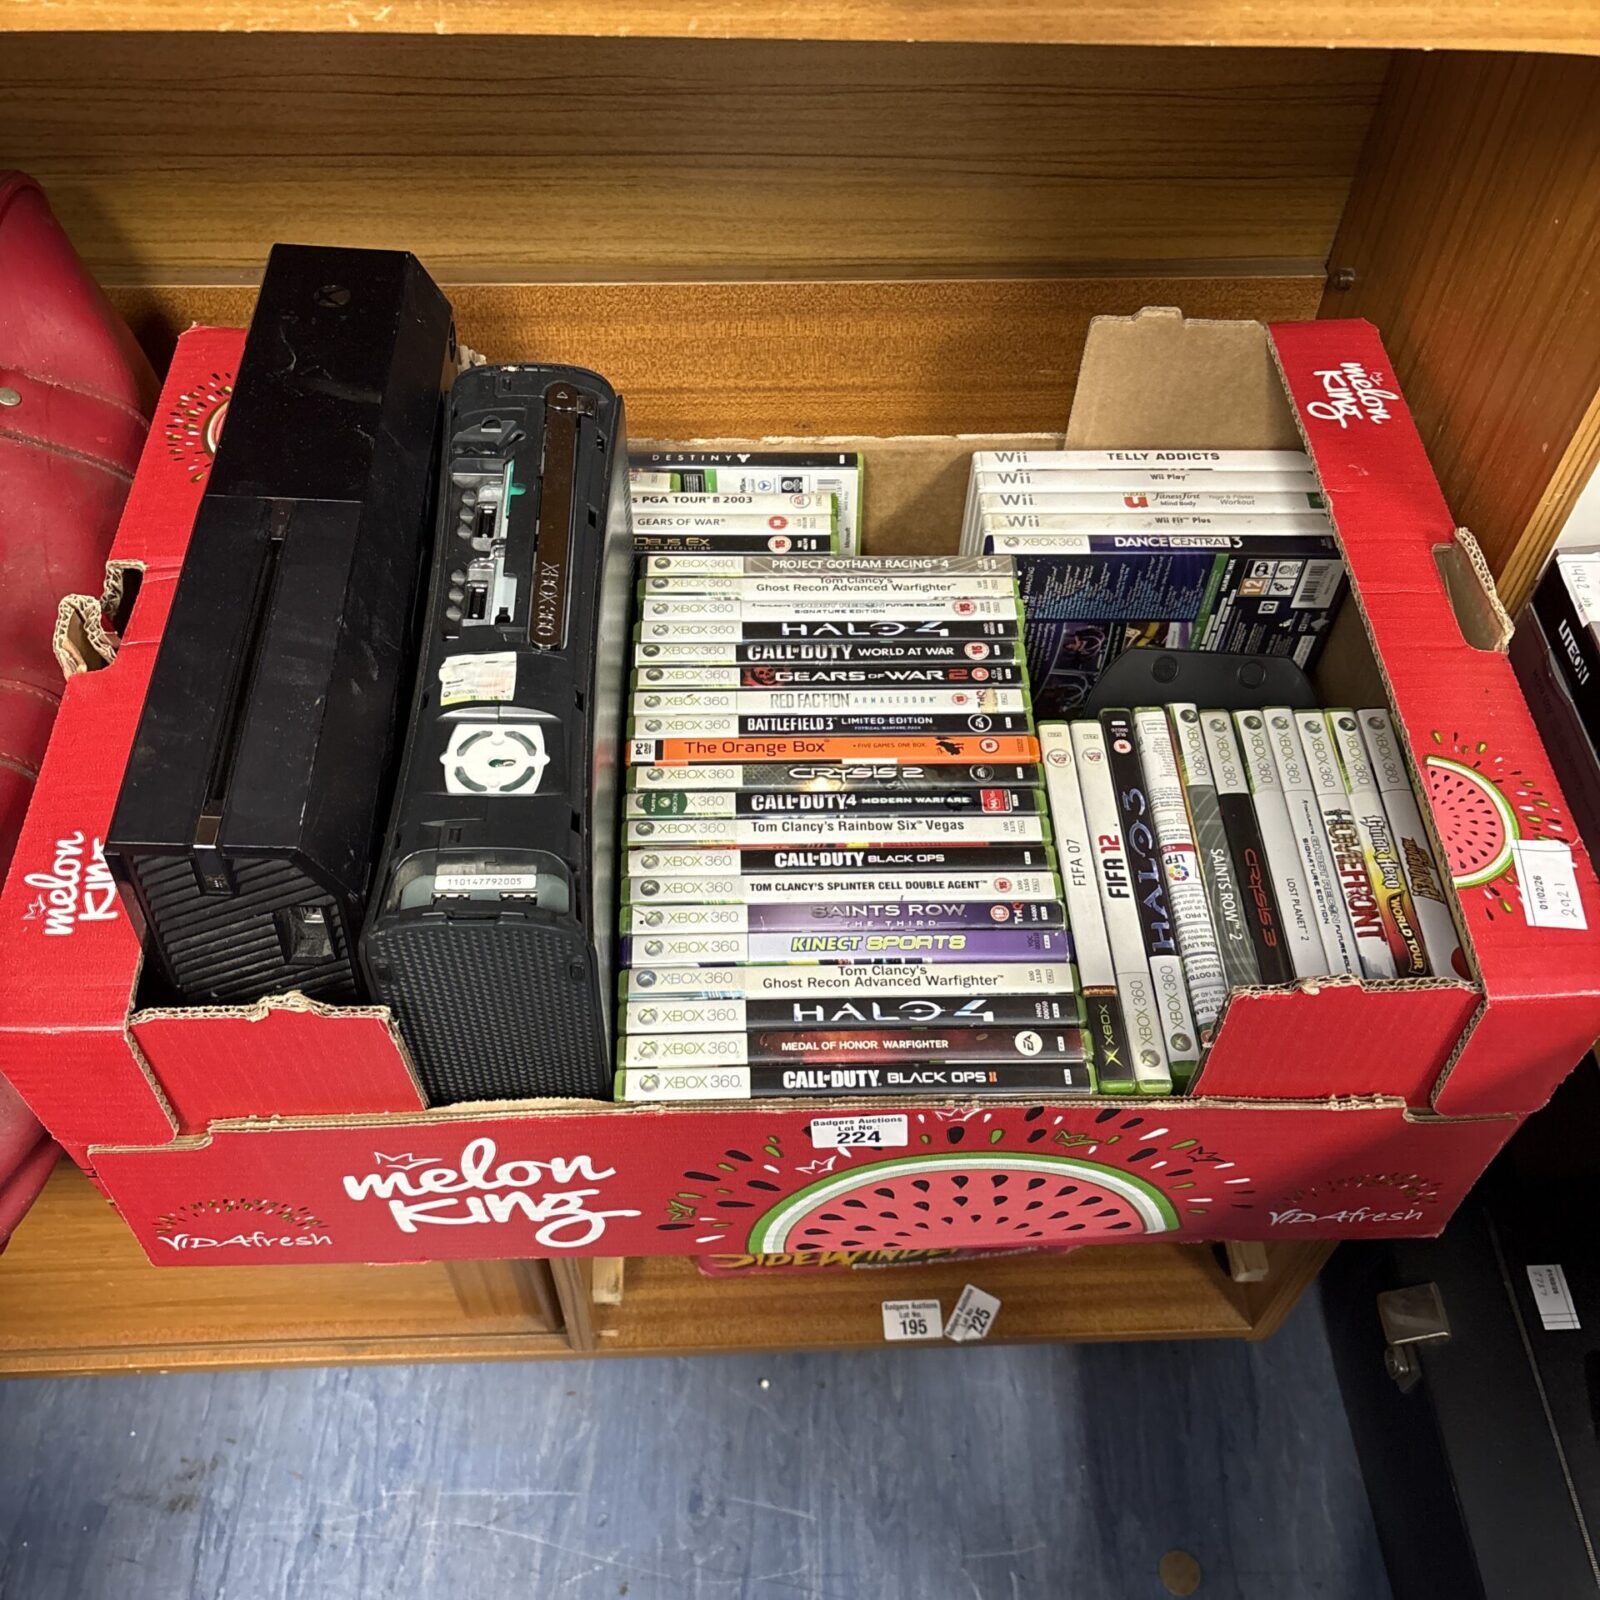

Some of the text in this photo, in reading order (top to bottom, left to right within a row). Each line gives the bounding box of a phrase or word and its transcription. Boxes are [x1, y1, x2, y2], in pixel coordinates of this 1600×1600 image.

[1340, 362, 1399, 424] melon
[995, 452, 1027, 463] Wii
[1156, 452, 1220, 460] ADDICTS
[998, 473, 1031, 484] Wii
[1000, 494, 1034, 505] Wii
[638, 518, 692, 526] GEARS OF
[1007, 516, 1040, 527] Wii
[1023, 537, 1082, 546] XBOX 360
[1114, 537, 1243, 548] DANCE CENTRAL 3
[772, 559, 949, 569] PROJECT GOTHAM 4
[672, 579, 732, 588] XBOX 360
[757, 583, 887, 592] Ghost Recon Advanced
[847, 576, 893, 585] Clancy's
[537, 562, 560, 636] XBOX 360
[672, 626, 735, 635] XBOX 360
[782, 621, 949, 637] HALO 4
[747, 644, 954, 660] CALL DUTY WORLD AT WAR
[1558, 619, 1590, 685] LITEON
[667, 670, 730, 680] XBOX 360
[775, 669, 968, 682] GEARS WAR 2
[771, 693, 932, 708] RED FACTION ARMAGEDDON
[666, 720, 731, 730] XBOX 360
[747, 718, 824, 731] BATTLEFIELD
[889, 717, 933, 725] EDITION
[684, 741, 787, 757] The Orange
[1216, 735, 1238, 787] XBOX 360
[1278, 732, 1301, 784] XBOX 360
[1346, 733, 1370, 785] XBOX 360
[1375, 732, 1399, 784] XBOX 360
[668, 769, 734, 779] XBOX 360
[902, 767, 924, 778] 2
[751, 795, 794, 810] CALL
[1122, 788, 1145, 816] 3
[658, 823, 726, 833] XBOX 360
[753, 820, 965, 834] Tom Clancy's Rainbow Vegas
[775, 852, 945, 868] CALL DUTY BLACK OPS
[1067, 839, 1086, 886] FIFA 07
[1099, 835, 1130, 899] FIFA 12
[1211, 849, 1232, 890] SAINTS
[1324, 809, 1387, 944] HOMEFRONT
[24, 831, 85, 935] melon
[664, 882, 733, 893] XBOX 360
[750, 881, 945, 891] TOM CLANCY'S SPLINTER CELL DOUBLE
[1129, 820, 1175, 952] HALO
[1286, 878, 1298, 897] LOST
[1303, 838, 1320, 887] SIGNATURE
[1316, 890, 1330, 925] EDITION
[1244, 848, 1277, 947] CRYSIS 3
[812, 904, 900, 918] SAINTS
[1390, 896, 1424, 970] WORLD TOUR
[668, 940, 740, 953] XBOX 360
[791, 935, 966, 952] KINECT SPORTS
[839, 965, 927, 977] Tom Clancy's
[763, 976, 921, 989] Ghost Recon Advanced
[1160, 966, 1186, 1030] XBOX 360
[662, 1009, 738, 1022] XBOX 360
[794, 1000, 994, 1022] HALO 4
[1129, 980, 1153, 1047] XBOX 360
[1098, 1004, 1115, 1045] XBOX
[781, 1040, 949, 1051] MEDAL OF HONOR WARFIGHTER
[664, 1075, 742, 1089] XBOX 360
[783, 1071, 986, 1088] CALL BLACK OPS
[813, 1116, 903, 1127] Badgers Auctions
[837, 1131, 882, 1144] 224
[343, 1137, 616, 1200] melon
[900, 1320, 928, 1335] 195
[968, 1307, 991, 1335] 225
